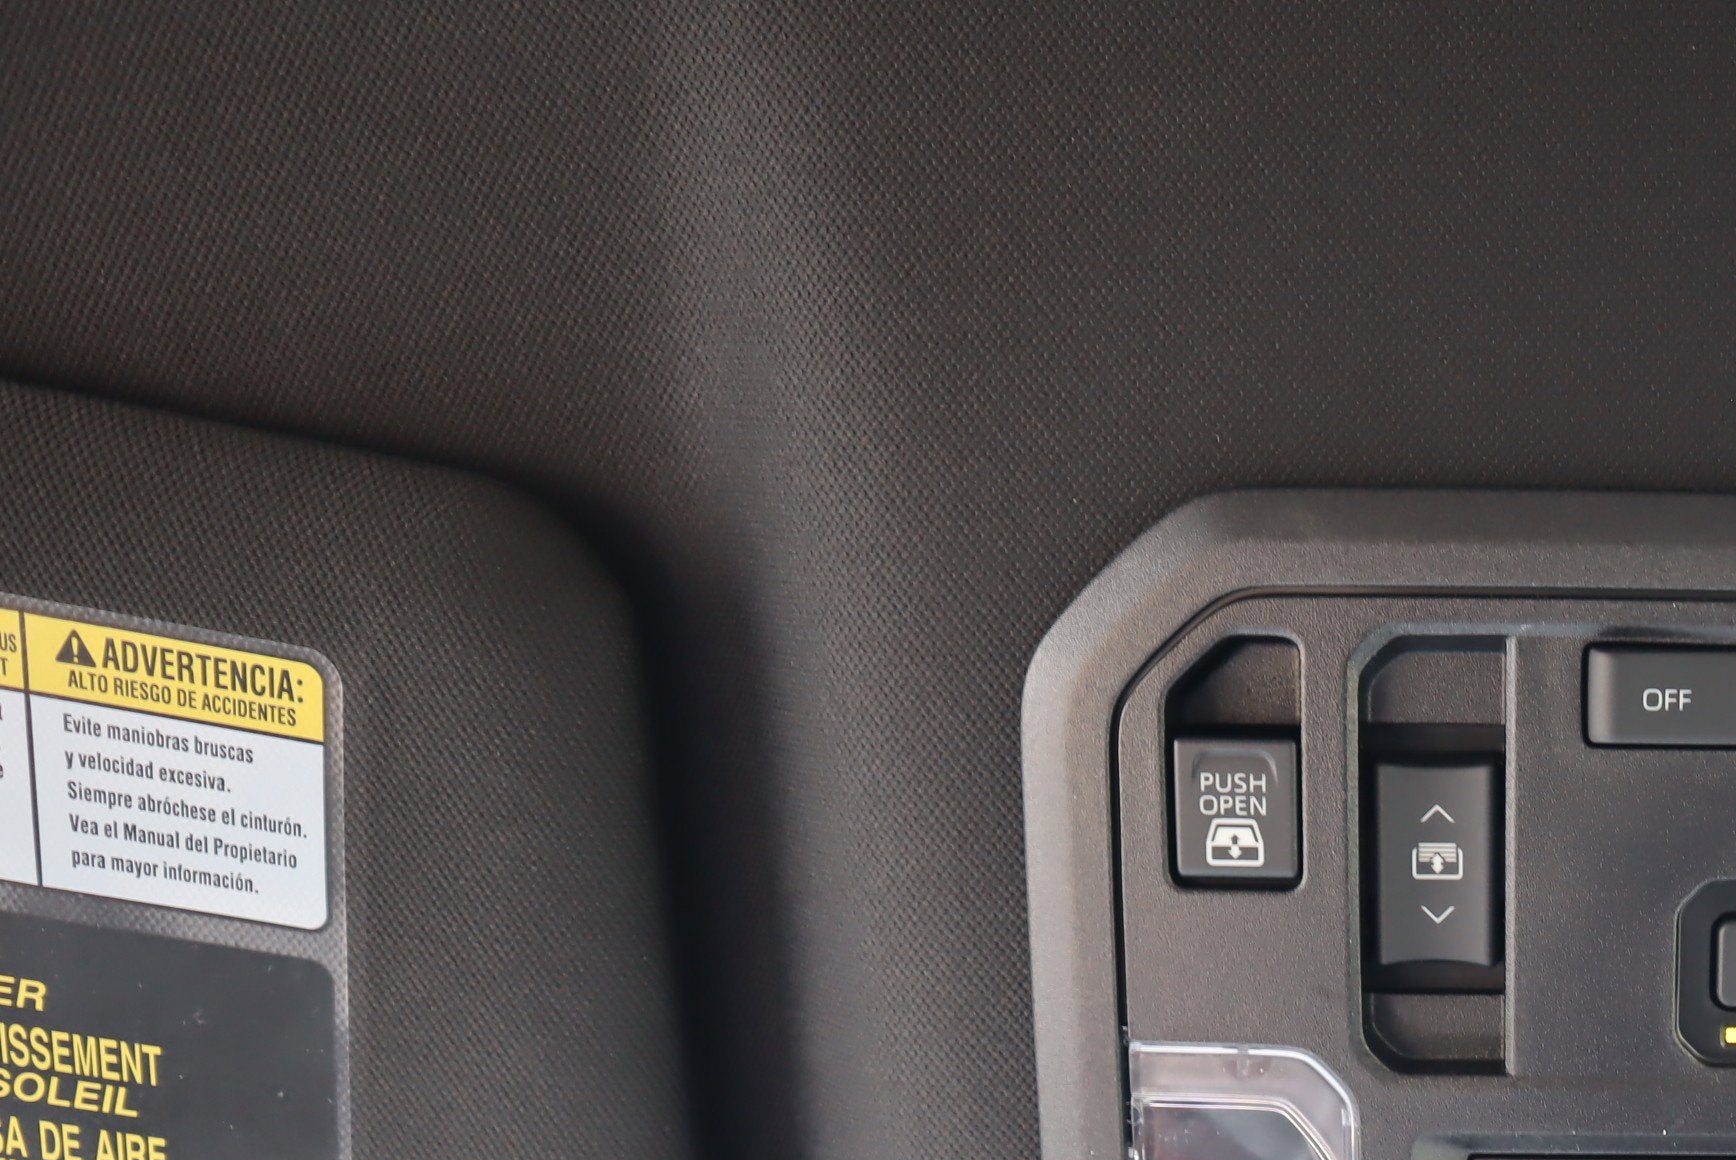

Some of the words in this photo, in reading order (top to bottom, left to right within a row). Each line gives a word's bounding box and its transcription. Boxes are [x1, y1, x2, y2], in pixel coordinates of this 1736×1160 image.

[102, 637, 304, 703] ADVERTENCIA:
[68, 670, 108, 693] ALTO
[114, 677, 171, 704] RIESGO
[177, 689, 197, 709] DE
[201, 693, 296, 726] ACCIDENTES
[1642, 689, 1692, 711] OFF
[63, 713, 101, 738] Evite
[107, 723, 189, 752] maniobras
[194, 735, 253, 764] bruscas
[65, 751, 74, 769] y
[78, 753, 153, 780] velocidad
[159, 766, 231, 793] excesiva.
[1200, 773, 1266, 793] PUSH
[68, 781, 133, 810] Siempre
[138, 792, 216, 823] abróchese
[222, 803, 235, 826] el
[240, 811, 307, 838] cinturón.
[1200, 795, 1266, 815] OPEN
[69, 814, 98, 836] Vea
[104, 820, 118, 839] el
[124, 823, 180, 849] Manual
[185, 832, 208, 854] del
[214, 838, 297, 868] Propietario
[72, 849, 106, 868] para
[111, 856, 158, 880] mayor
[163, 861, 259, 893] información.
